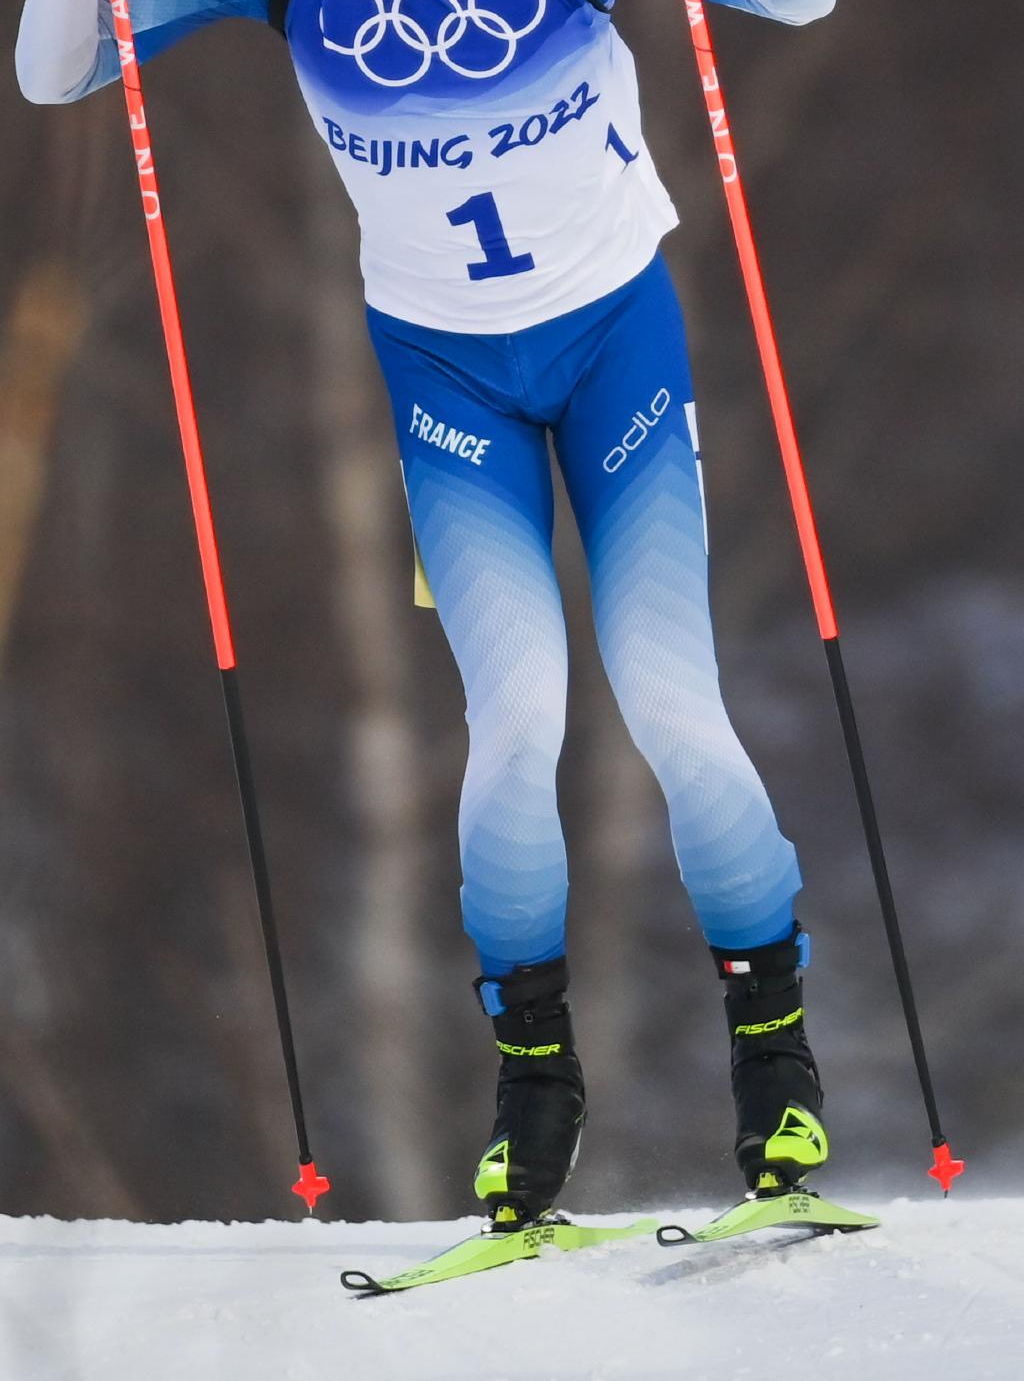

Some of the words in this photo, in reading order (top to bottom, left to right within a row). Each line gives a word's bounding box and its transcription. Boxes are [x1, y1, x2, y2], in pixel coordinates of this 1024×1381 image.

[322, 116, 473, 176] BEIJING
[488, 81, 601, 159] 2022
[604, 121, 640, 174] 1
[446, 191, 536, 281] 1
[409, 403, 492, 466] FRANCE
